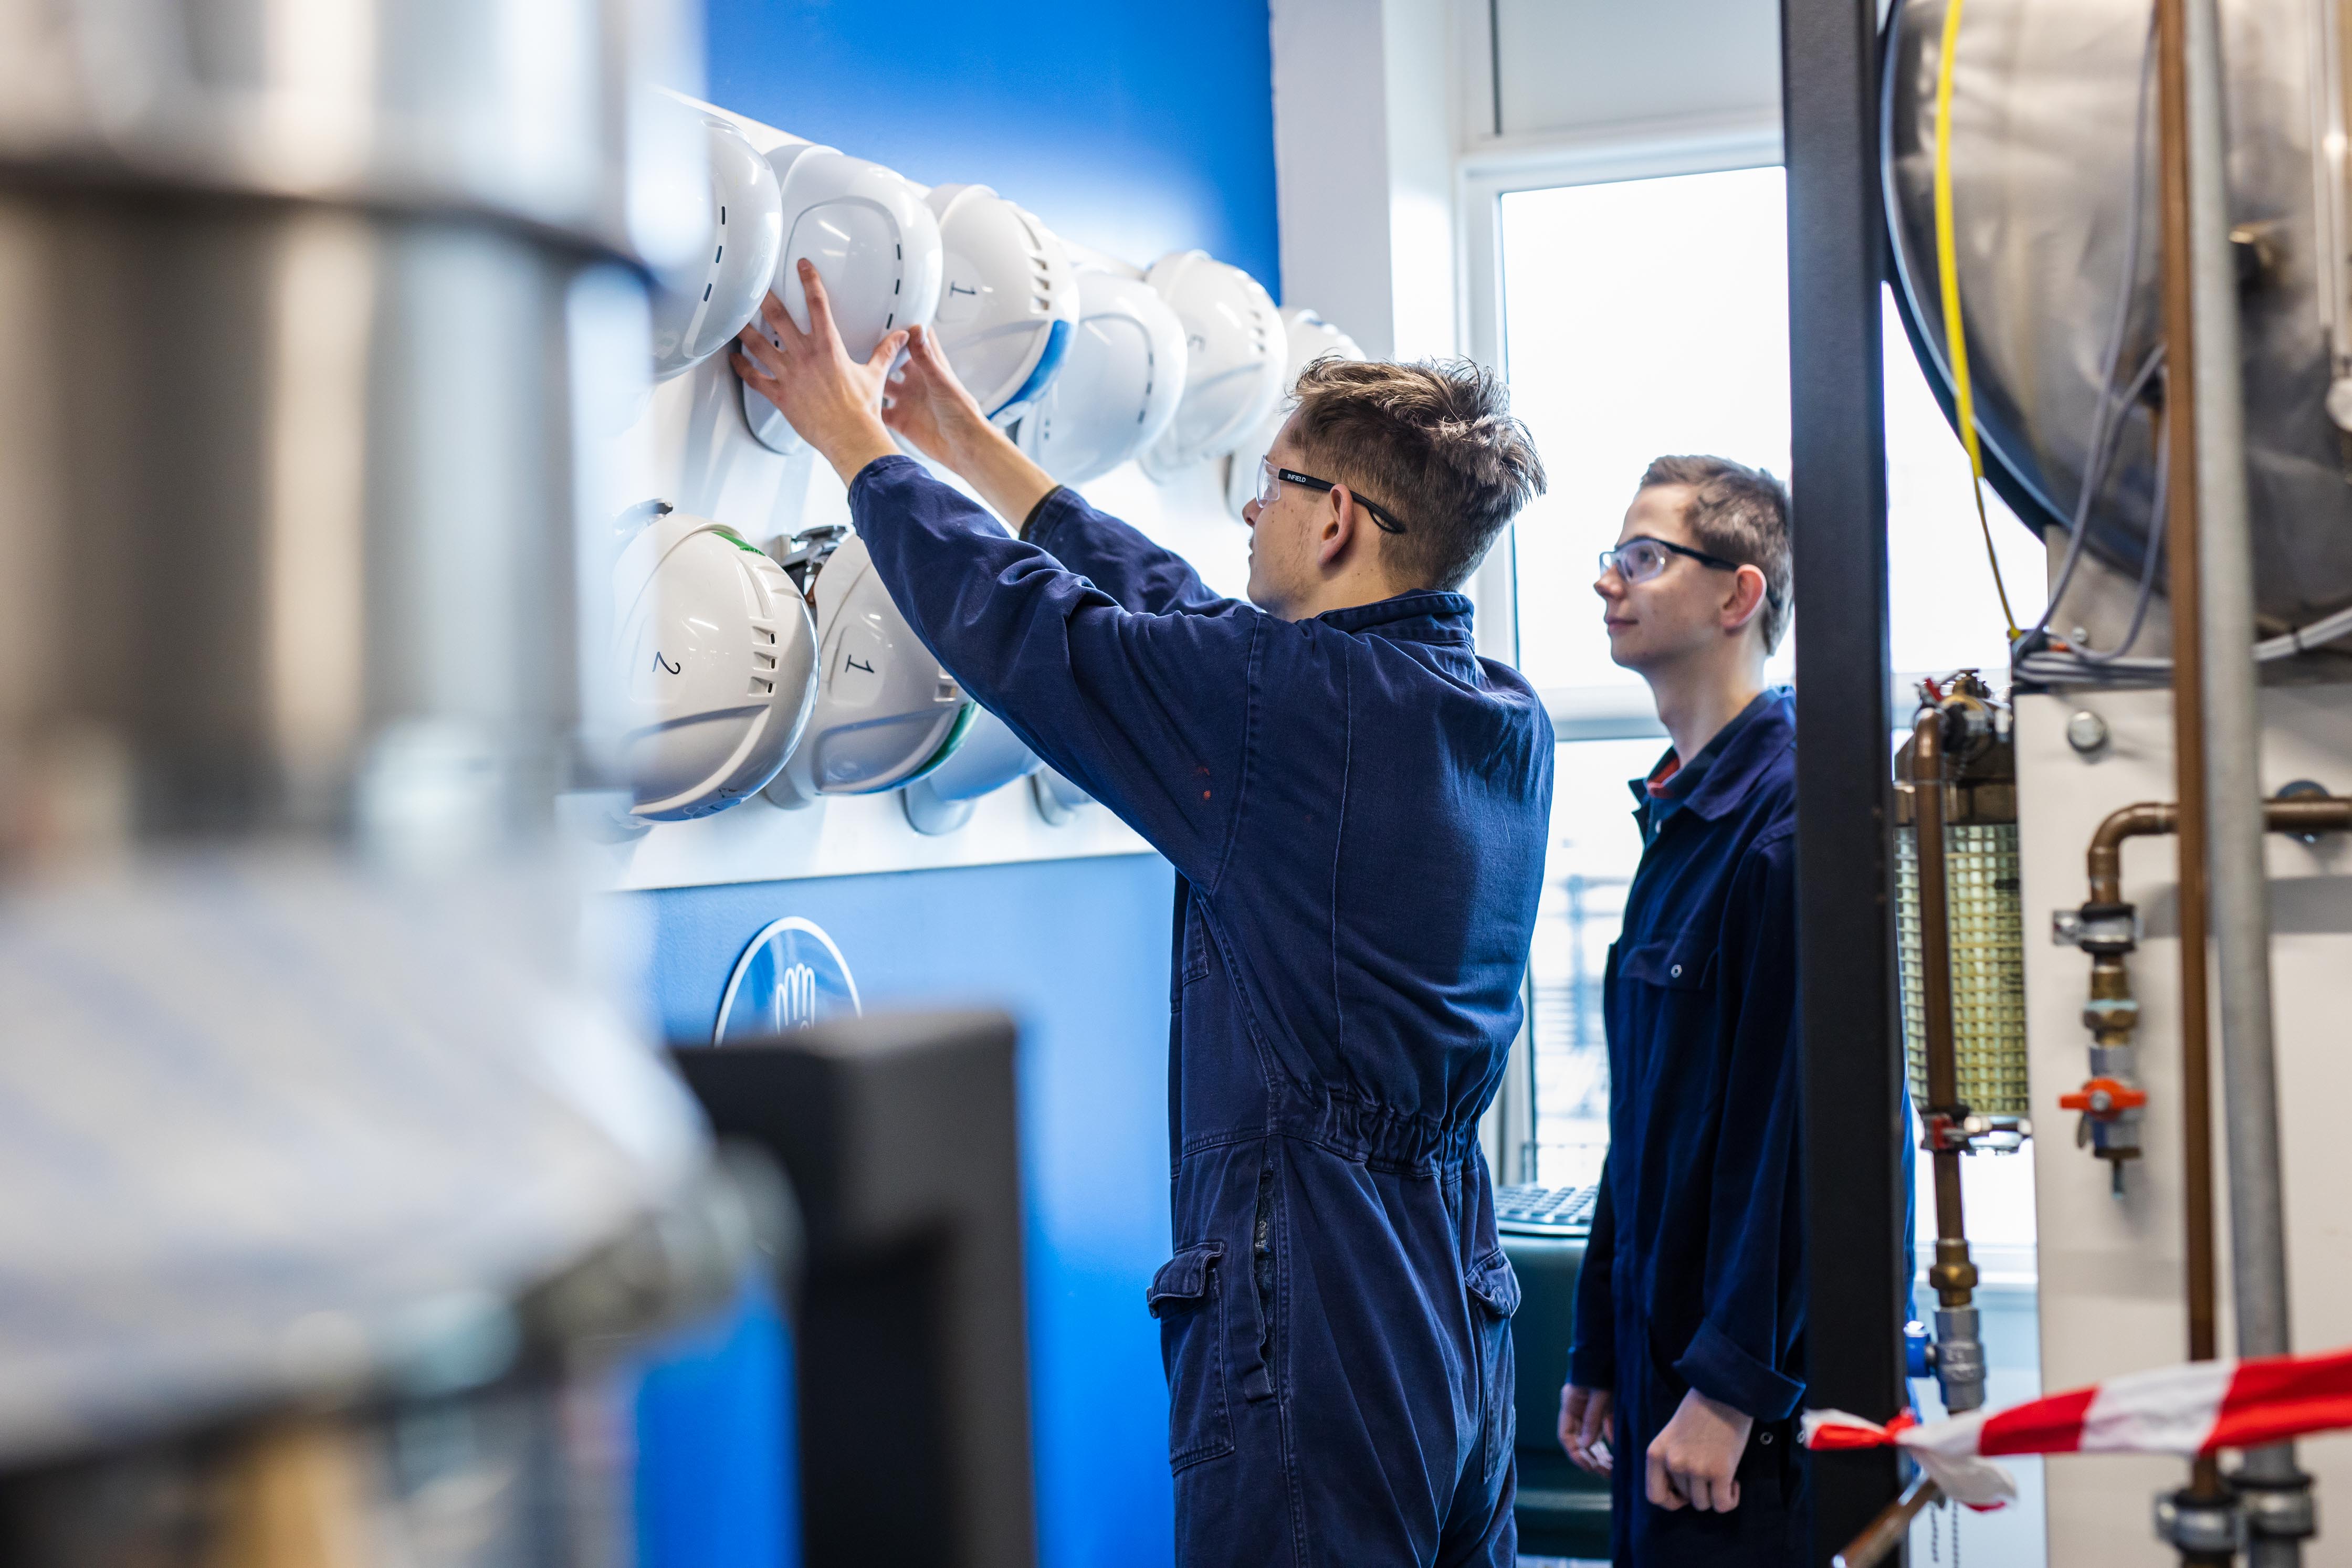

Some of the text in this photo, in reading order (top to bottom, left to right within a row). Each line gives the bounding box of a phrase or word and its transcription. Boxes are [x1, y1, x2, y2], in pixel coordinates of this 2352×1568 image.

[949, 280, 976, 298] 1
[1287, 473, 1306, 482] INFIELD
[652, 651, 681, 675] 2
[845, 654, 875, 673] 1
